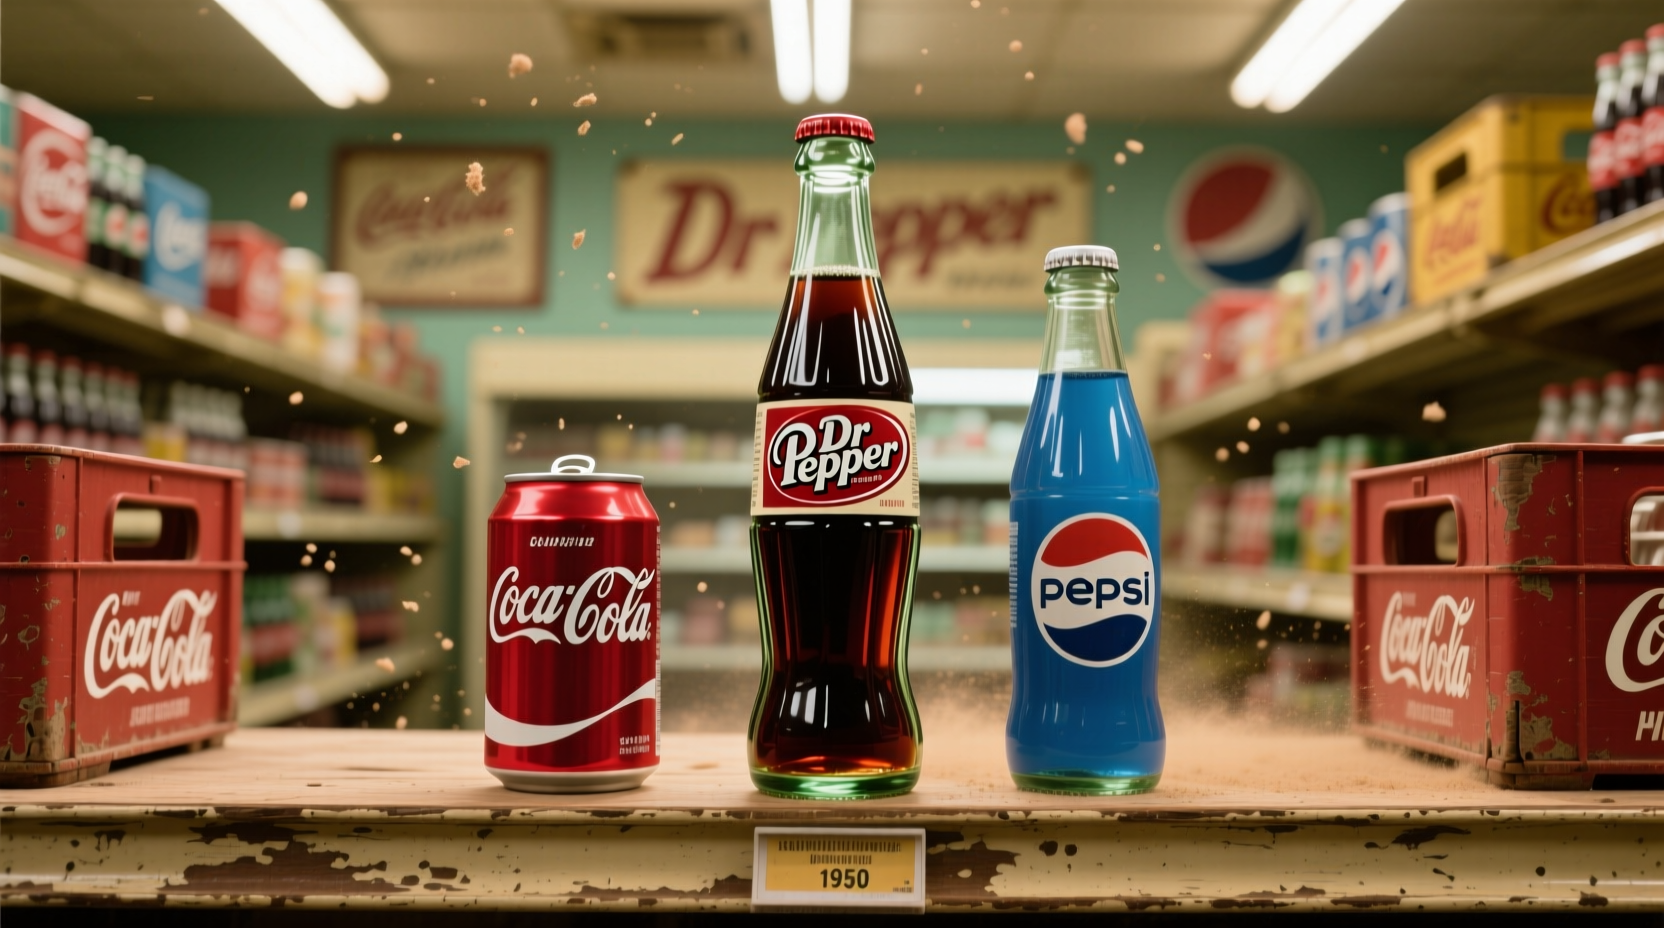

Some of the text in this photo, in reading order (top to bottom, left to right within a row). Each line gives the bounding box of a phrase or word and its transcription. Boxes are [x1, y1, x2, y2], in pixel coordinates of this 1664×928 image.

[646, 177, 778, 286] Dr
[773, 422, 898, 491] Pepper
[819, 415, 871, 452] Dr
[489, 566, 655, 645] Coca-Cola
[1041, 571, 1149, 609] pepsi
[84, 588, 218, 699] Coca-Cola
[1380, 591, 1475, 699] Coca-Cola
[820, 868, 870, 889] 1950
